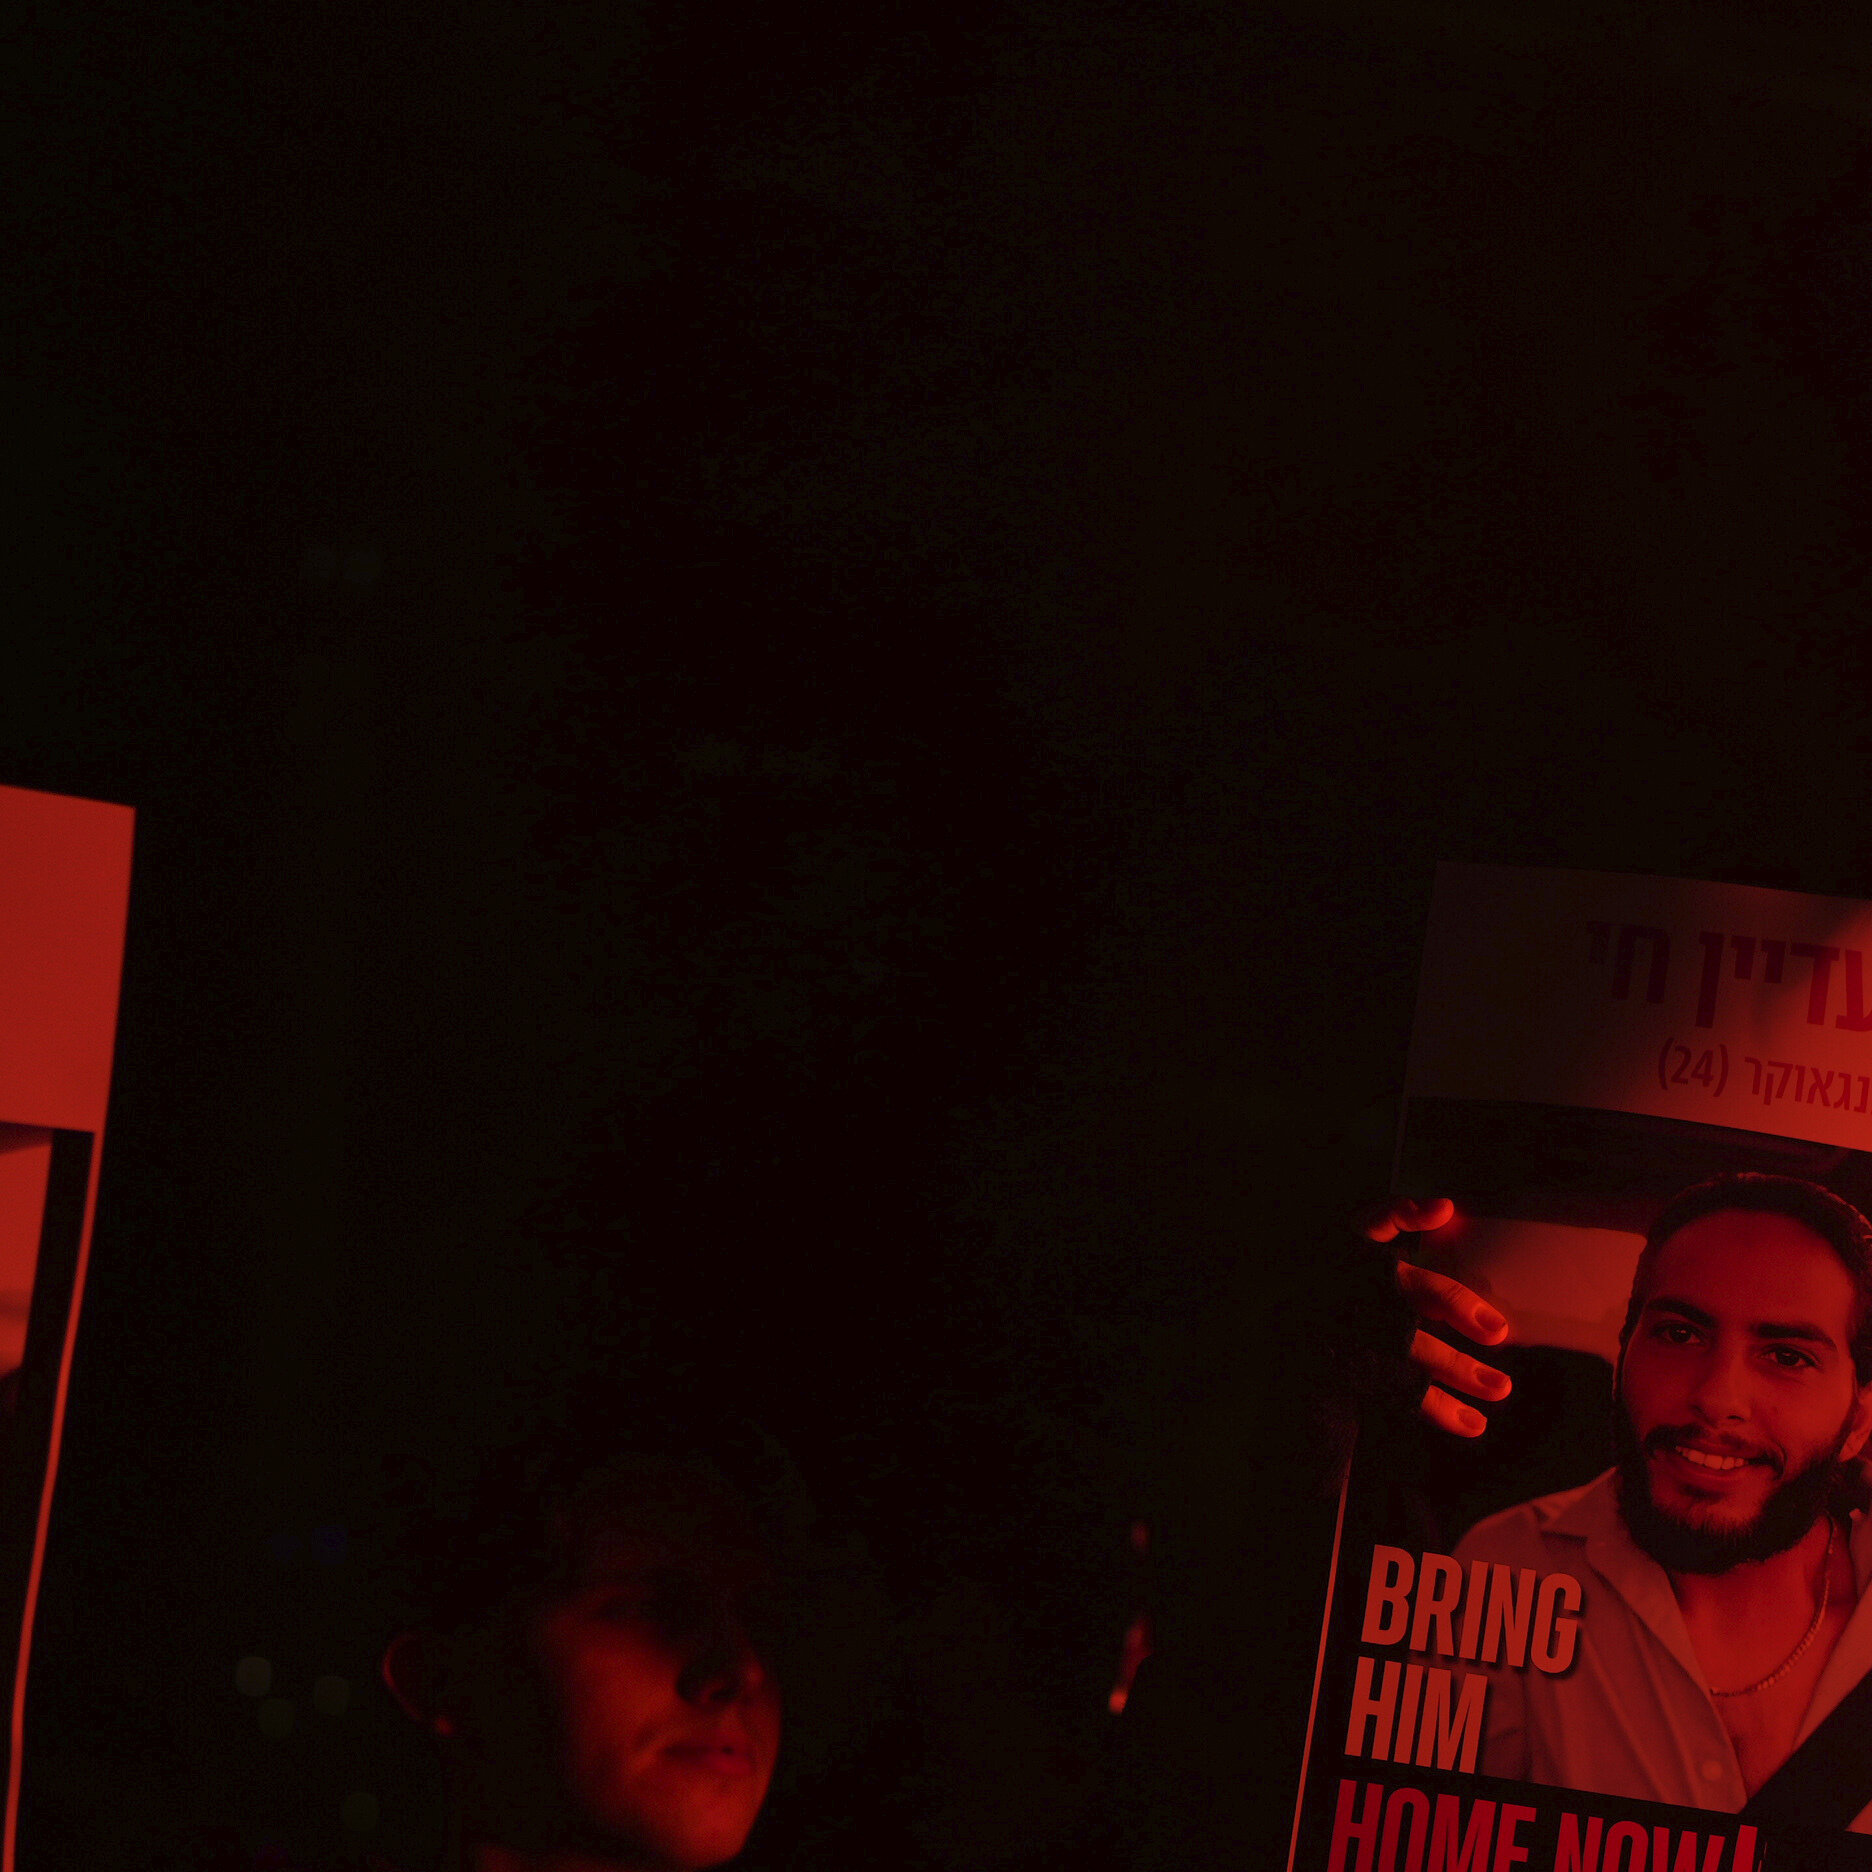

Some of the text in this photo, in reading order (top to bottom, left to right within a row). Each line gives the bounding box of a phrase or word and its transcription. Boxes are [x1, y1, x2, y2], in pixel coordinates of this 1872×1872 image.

[1586, 919, 1671, 1008] חי
[1656, 1037, 1730, 1098] (24)
[1359, 1542, 1584, 1680] BRING
[1344, 1656, 1488, 1774] HIM
